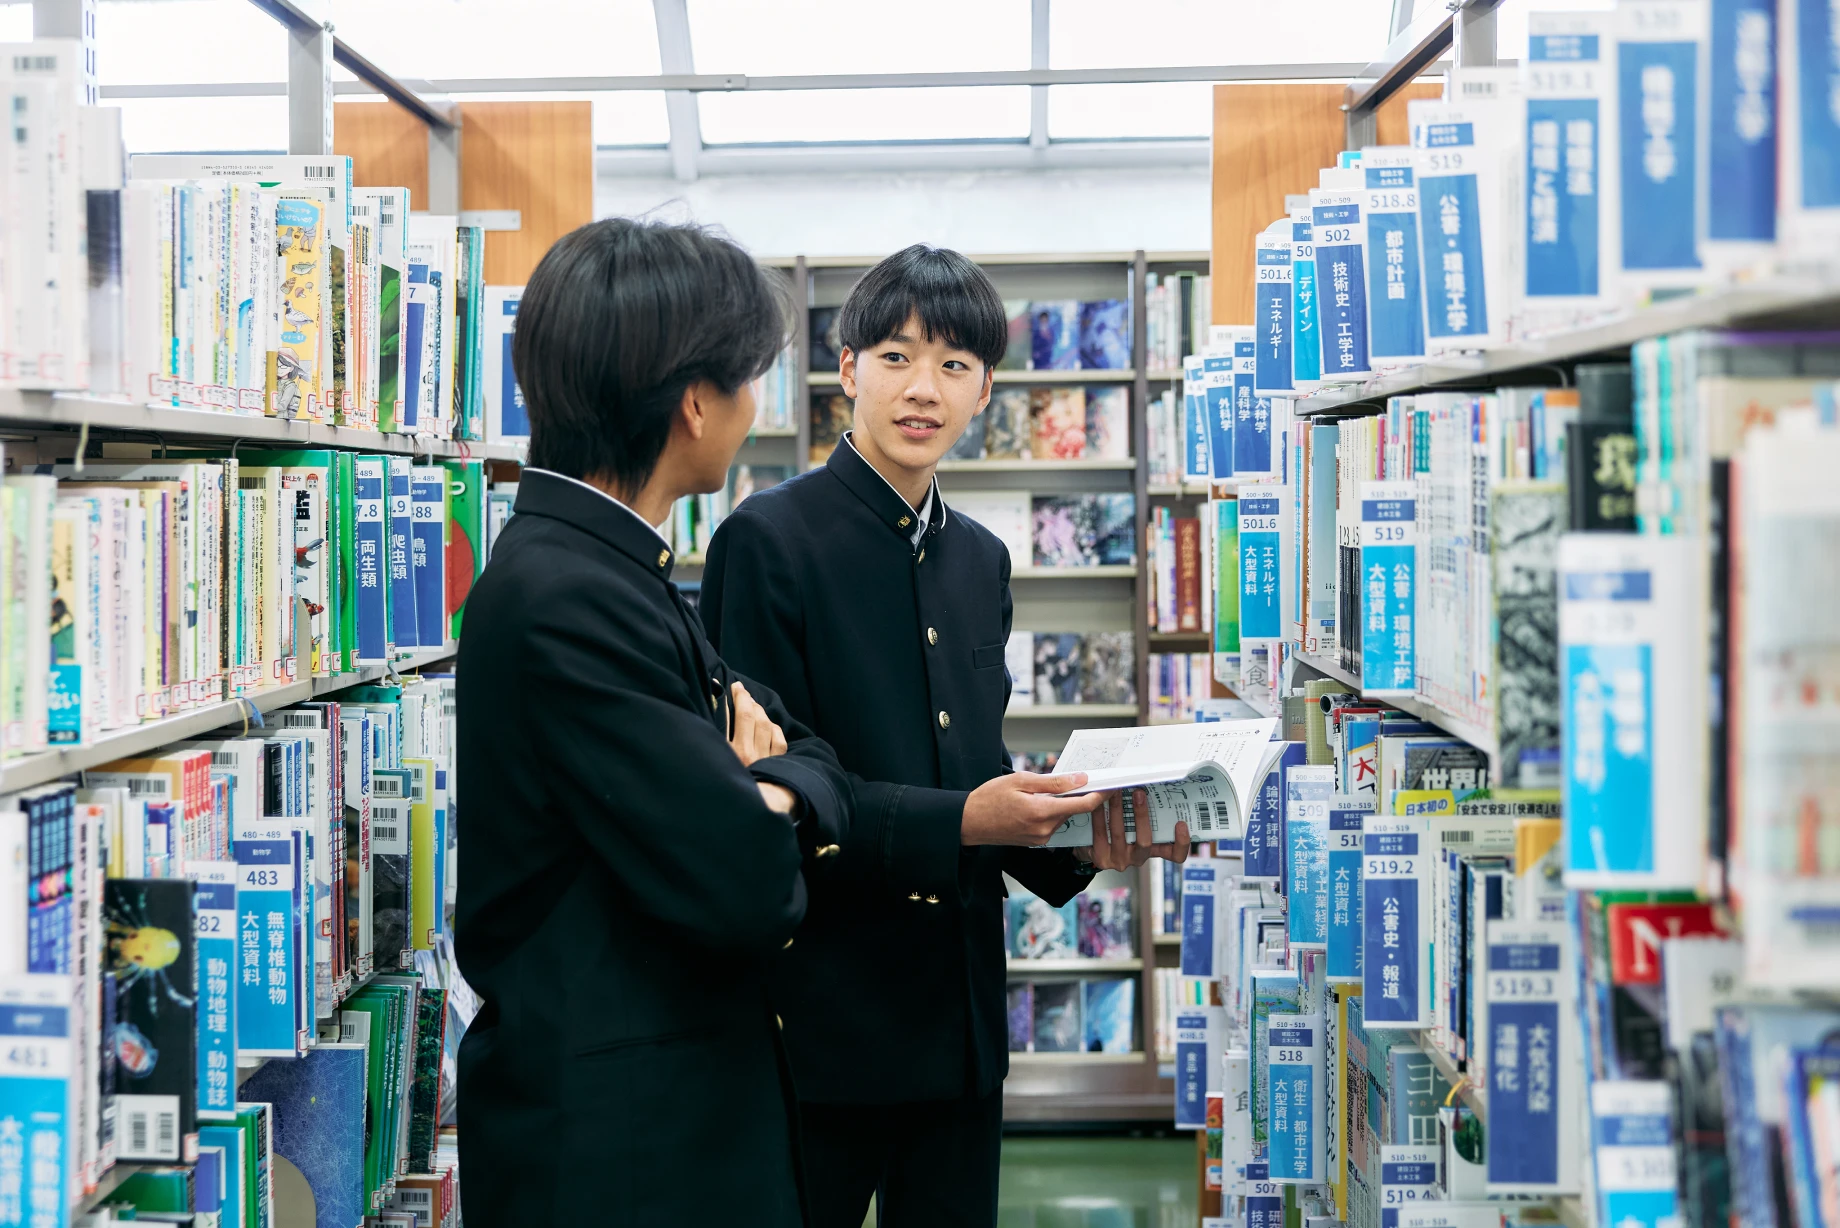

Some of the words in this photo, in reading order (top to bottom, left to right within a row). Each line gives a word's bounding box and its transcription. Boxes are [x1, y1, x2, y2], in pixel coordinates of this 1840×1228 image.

[1430, 153, 1463, 170] 519
[1370, 193, 1416, 209] 518.8
[1325, 228, 1351, 243] 502
[1385, 230, 1406, 300] 都市計画
[1439, 193, 1469, 333] 公害・環境工学
[1270, 297, 1283, 360] エネルギー
[1298, 276, 1313, 332] デザイン
[1332, 261, 1356, 368] 技術史・工学史
[1218, 397, 1233, 432] 外科学
[1238, 385, 1251, 422] 産科学
[412, 506, 432, 519] 88
[1243, 518, 1277, 529] 501.6
[1374, 526, 1405, 541] 519
[360, 539, 377, 588] 両生類
[392, 533, 408, 580] 爬虫類
[413, 537, 427, 568] 鳥類
[1244, 545, 1258, 596] 大型資料
[1262, 546, 1275, 608] エネルギー
[1368, 562, 1387, 633] 大型資料
[1393, 562, 1412, 685] 公害・環境工学
[1248, 790, 1261, 860] 術エッセイ
[1266, 785, 1279, 848] 論文・評論
[1298, 803, 1324, 818] 509
[1395, 824, 1410, 832] 519
[1405, 798, 1449, 817] 日本初の
[242, 831, 257, 839] 480
[265, 831, 282, 839] 489
[1379, 836, 1403, 844] 建設工学
[246, 870, 279, 886] 483
[1294, 835, 1309, 894] 大型資料
[1368, 860, 1414, 874] 519.2
[1333, 866, 1350, 927] 大型資料
[241, 910, 261, 987] 大型資料
[267, 911, 287, 1006] 無脊椎動物
[1382, 897, 1400, 999] 公害史・報道
[206, 957, 228, 1107] 動物地理・動物誌
[1278, 1050, 1303, 1062] 518
[1274, 1078, 1289, 1133] 大型資料
[1293, 1079, 1308, 1174] 衛生・都市工学
[1255, 1183, 1277, 1194] 507
